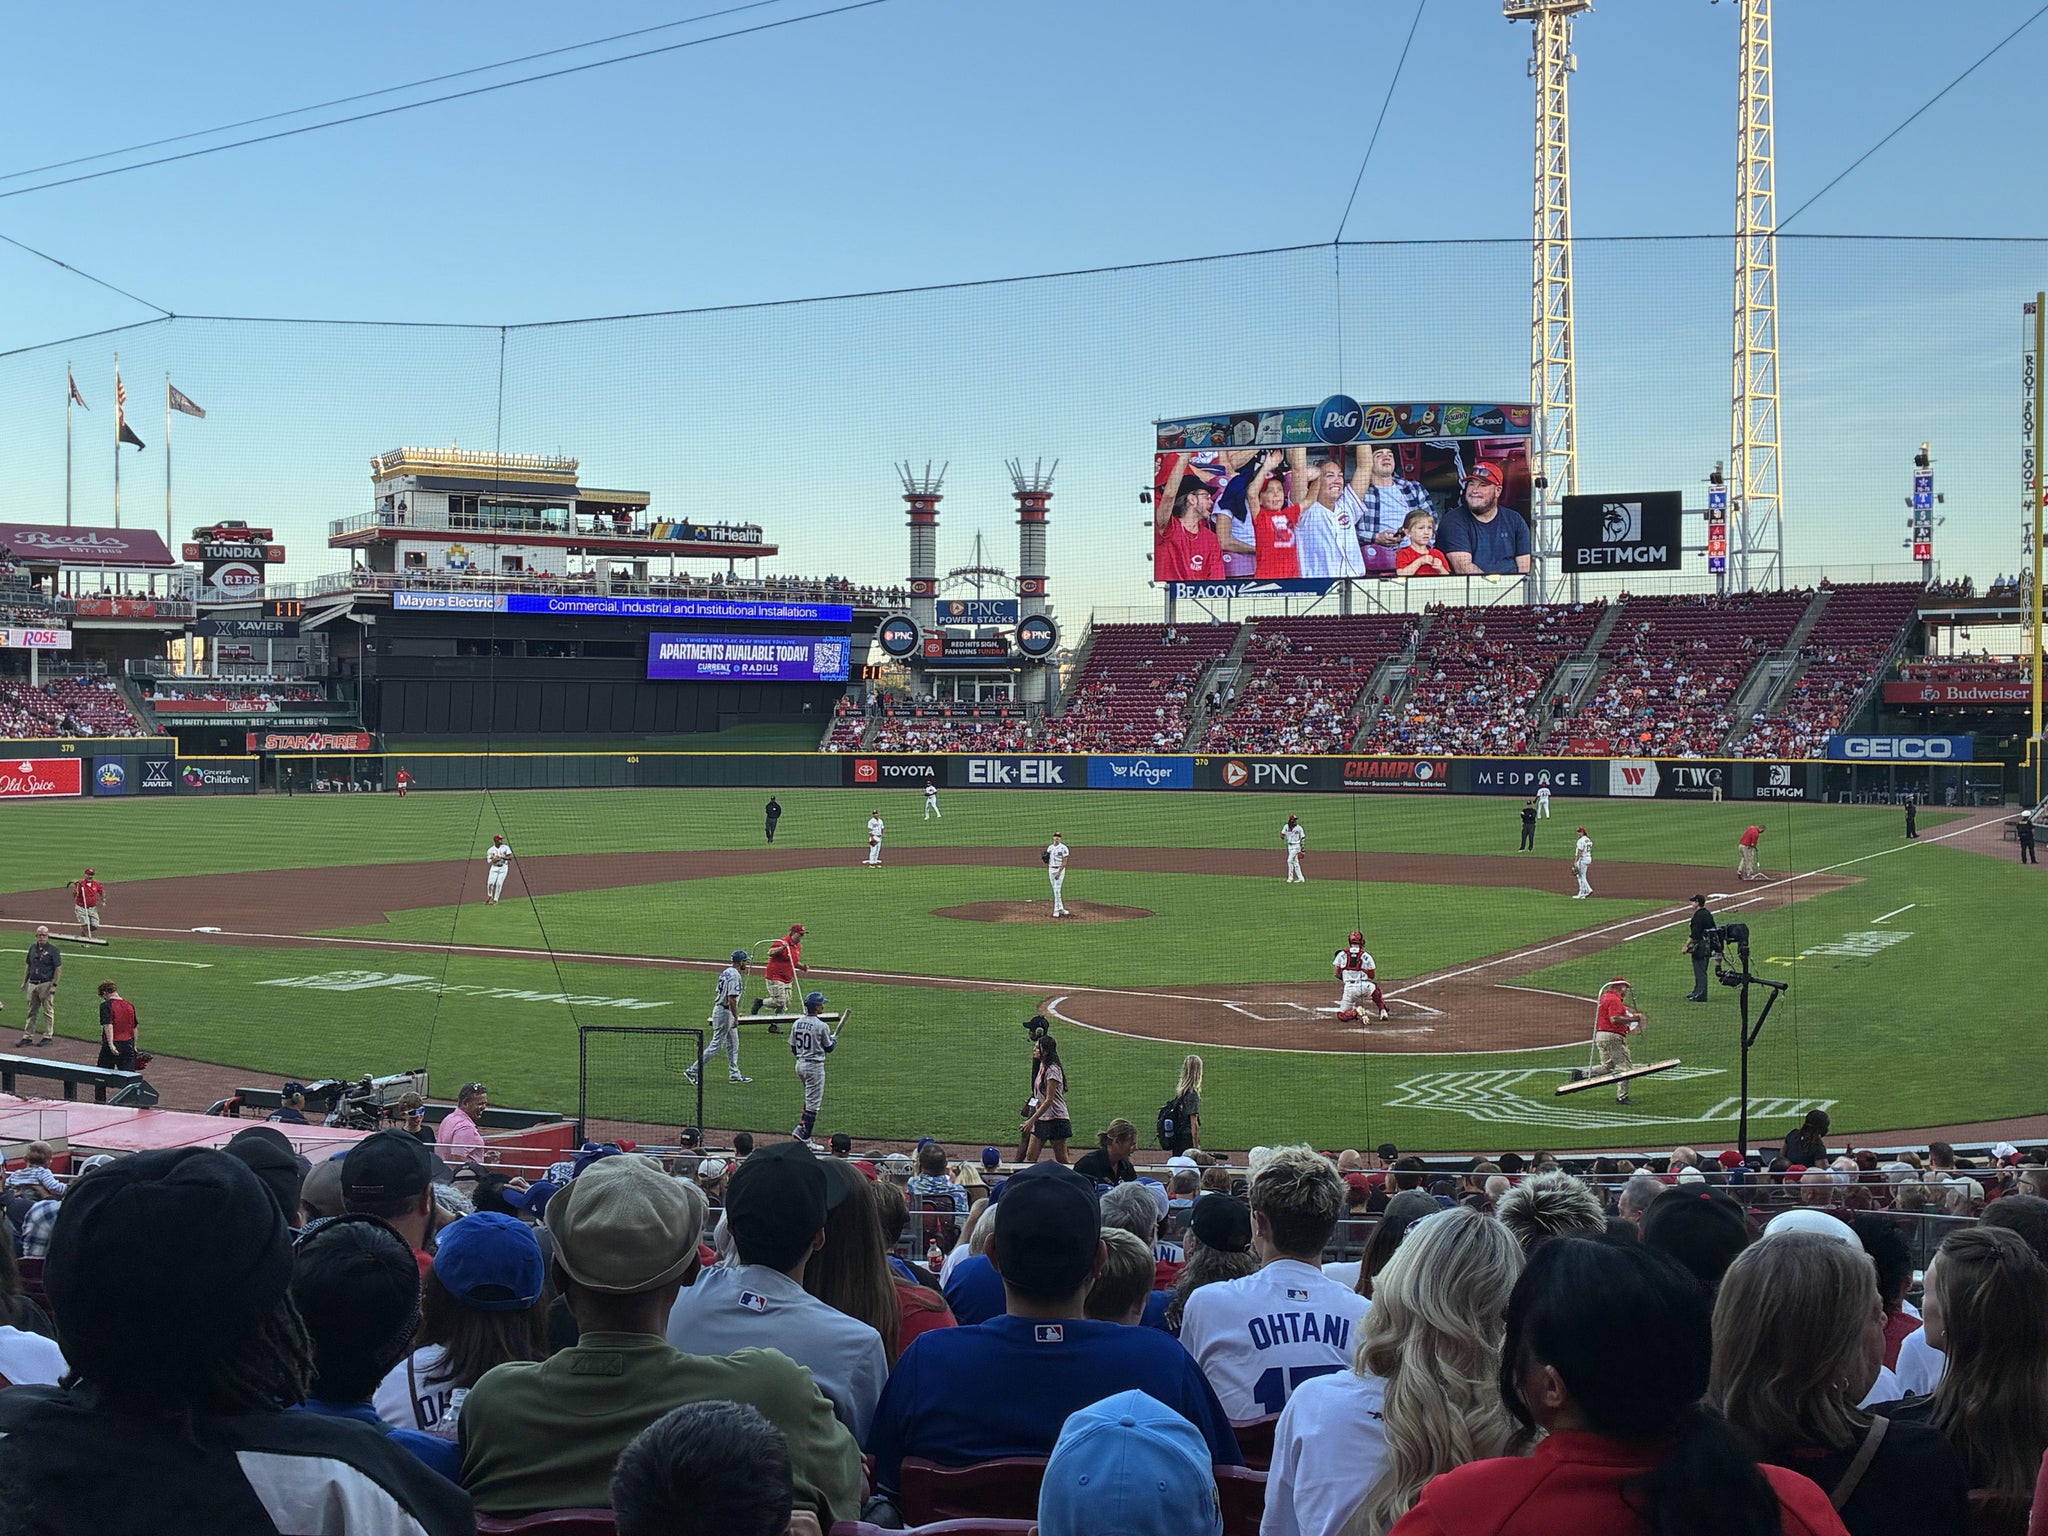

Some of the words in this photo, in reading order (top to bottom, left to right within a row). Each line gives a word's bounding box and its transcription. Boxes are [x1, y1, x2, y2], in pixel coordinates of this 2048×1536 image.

[2023, 355, 2035, 397] ROOT
[1324, 411, 1358, 429] P&G
[1366, 412, 1395, 432] Tide
[1443, 411, 1469, 425] Bounty
[2023, 400, 2035, 442] ROOT
[1285, 425, 1312, 435] Pampers
[14, 531, 126, 549] Reds
[708, 526, 763, 543] TriHealth
[204, 546, 262, 558] TUNDRA
[1577, 546, 1667, 565] BETMGM
[224, 575, 260, 585] REDS
[1175, 583, 1237, 599] BEACON
[400, 594, 445, 609] Mayers
[449, 596, 494, 609] Electric
[549, 599, 620, 614] Commercial,
[622, 601, 672, 614] Industrial
[674, 603, 694, 614] and
[697, 603, 757, 616] Institutional
[759, 605, 818, 618] Installations
[967, 602, 1004, 616] PNC
[238, 621, 284, 631] XAVIER
[939, 616, 974, 624] POWER
[977, 616, 1015, 624] STACKS
[22, 631, 58, 647] ROSE
[894, 631, 913, 640] PNC
[1031, 631, 1051, 639] PNC
[659, 643, 723, 661] APARTMENTS
[724, 644, 775, 662] AVAILABLE
[776, 646, 809, 662] TODAY!
[980, 641, 999, 649] SIGN,
[697, 663, 731, 673] CURRENT
[741, 664, 779, 672] RADIUS
[1947, 686, 2030, 700] Budweiser
[61, 744, 75, 753] 379
[264, 734, 307, 750] STAR
[321, 734, 358, 750] FIRE
[1844, 737, 1952, 759] GEICO
[626, 756, 640, 764] 404
[1195, 758, 1209, 766] 370
[203, 774, 251, 785] Children's
[882, 765, 935, 778] TOYOTA
[968, 759, 1064, 784] Elk+Elk
[1129, 760, 1173, 785] Kroger
[1251, 764, 1309, 785] PNC
[1478, 769, 1579, 786] MEDPACE
[22, 774, 54, 795] Spice
[1756, 787, 1804, 798] BETMGM
[795, 1032, 812, 1051] 50
[1247, 1311, 1350, 1351] OHTANI
